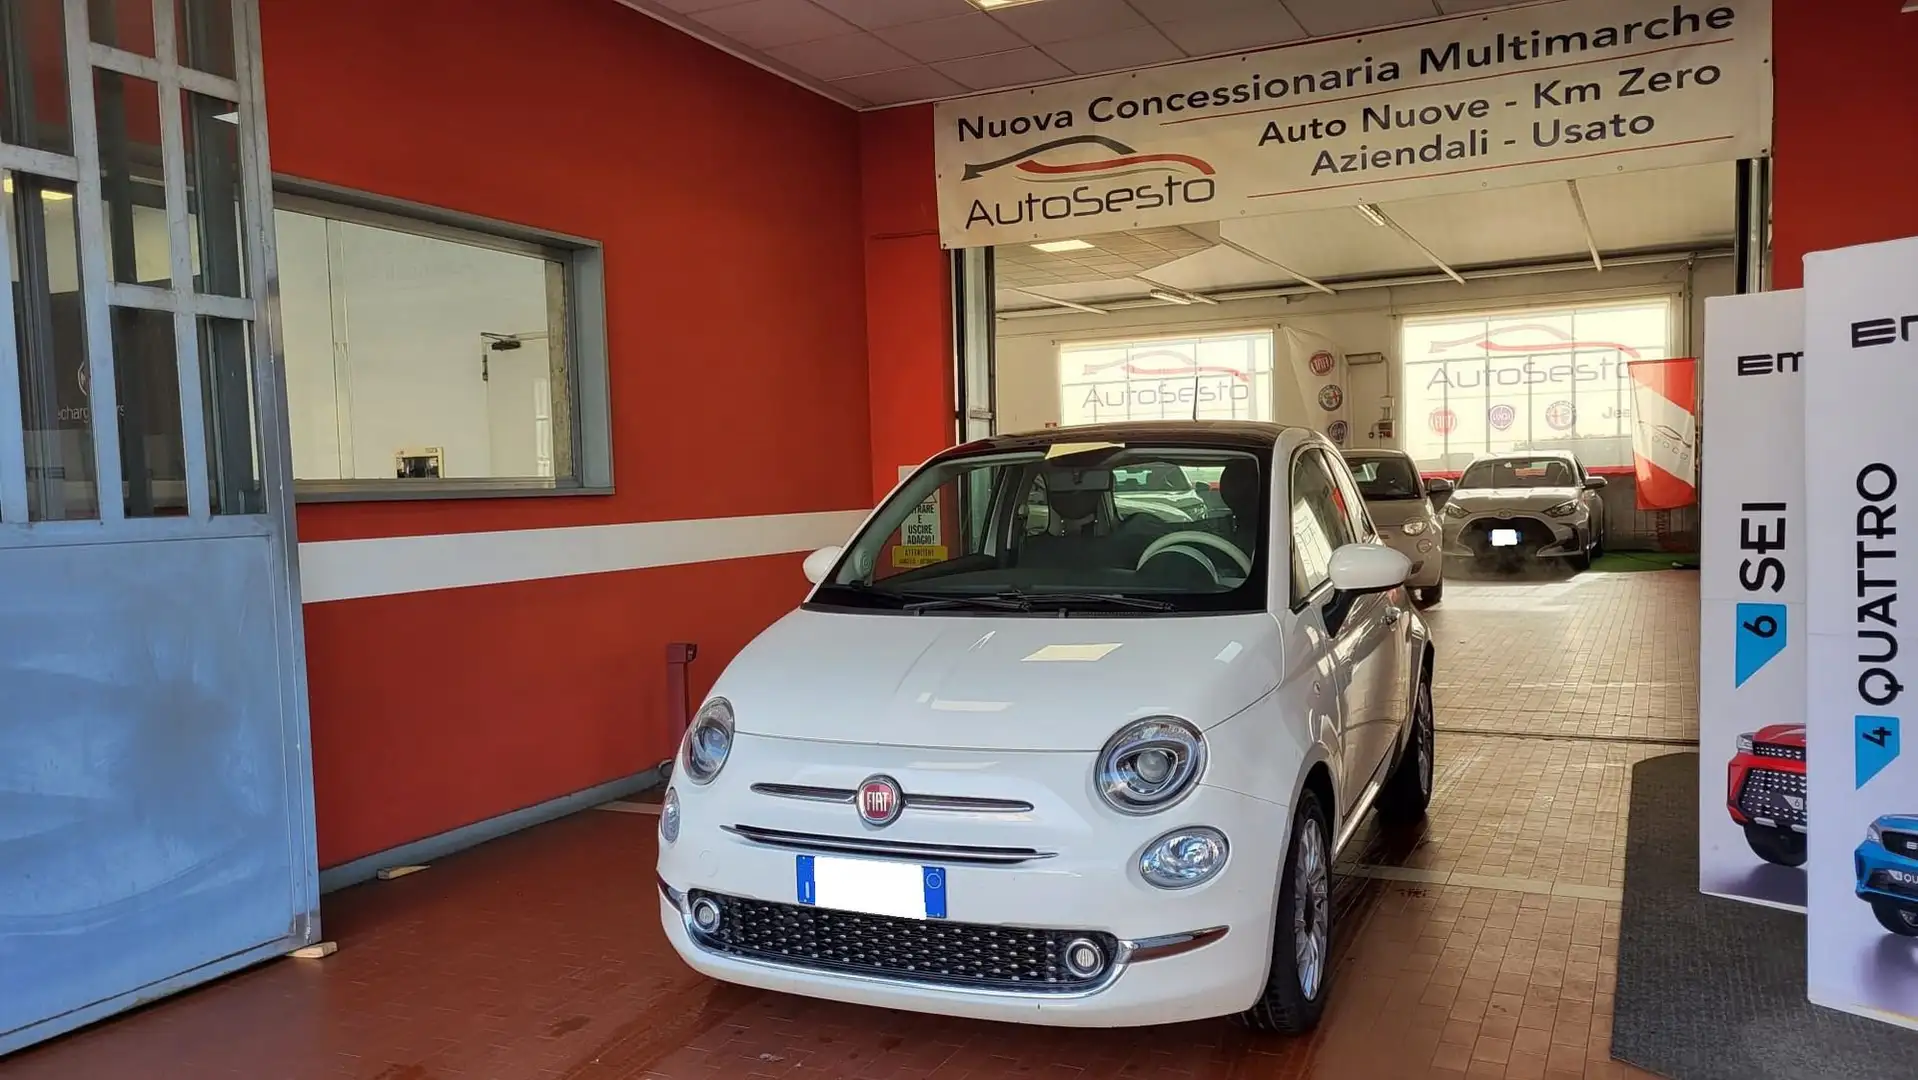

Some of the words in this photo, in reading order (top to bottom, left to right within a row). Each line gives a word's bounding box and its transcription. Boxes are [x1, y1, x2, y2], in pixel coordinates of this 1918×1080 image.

[957, 109, 1073, 142] Nuova
[1088, 56, 1400, 123] Concessionaria
[1420, 4, 1735, 75] Multimarche
[1258, 117, 1347, 147] Auto
[1363, 98, 1490, 133] Nuove
[1534, 79, 1601, 109] Km
[1618, 64, 1721, 97] Zero
[1311, 128, 1489, 176] Aziendali
[1533, 113, 1655, 148] Usato
[965, 174, 1215, 230] AutoSesto
[1081, 380, 1249, 409] AutoSesto
[1602, 406, 1631, 420] Jee
[908, 525, 933, 535] USCIRE
[918, 515, 923, 524] E
[907, 535, 935, 545] ADAGIO!
[1739, 502, 1787, 593] SEI
[1856, 462, 1904, 706] QUATTRO
[1743, 615, 1777, 638] 6
[1862, 726, 1892, 748] 4
[866, 791, 889, 812] FIAT
